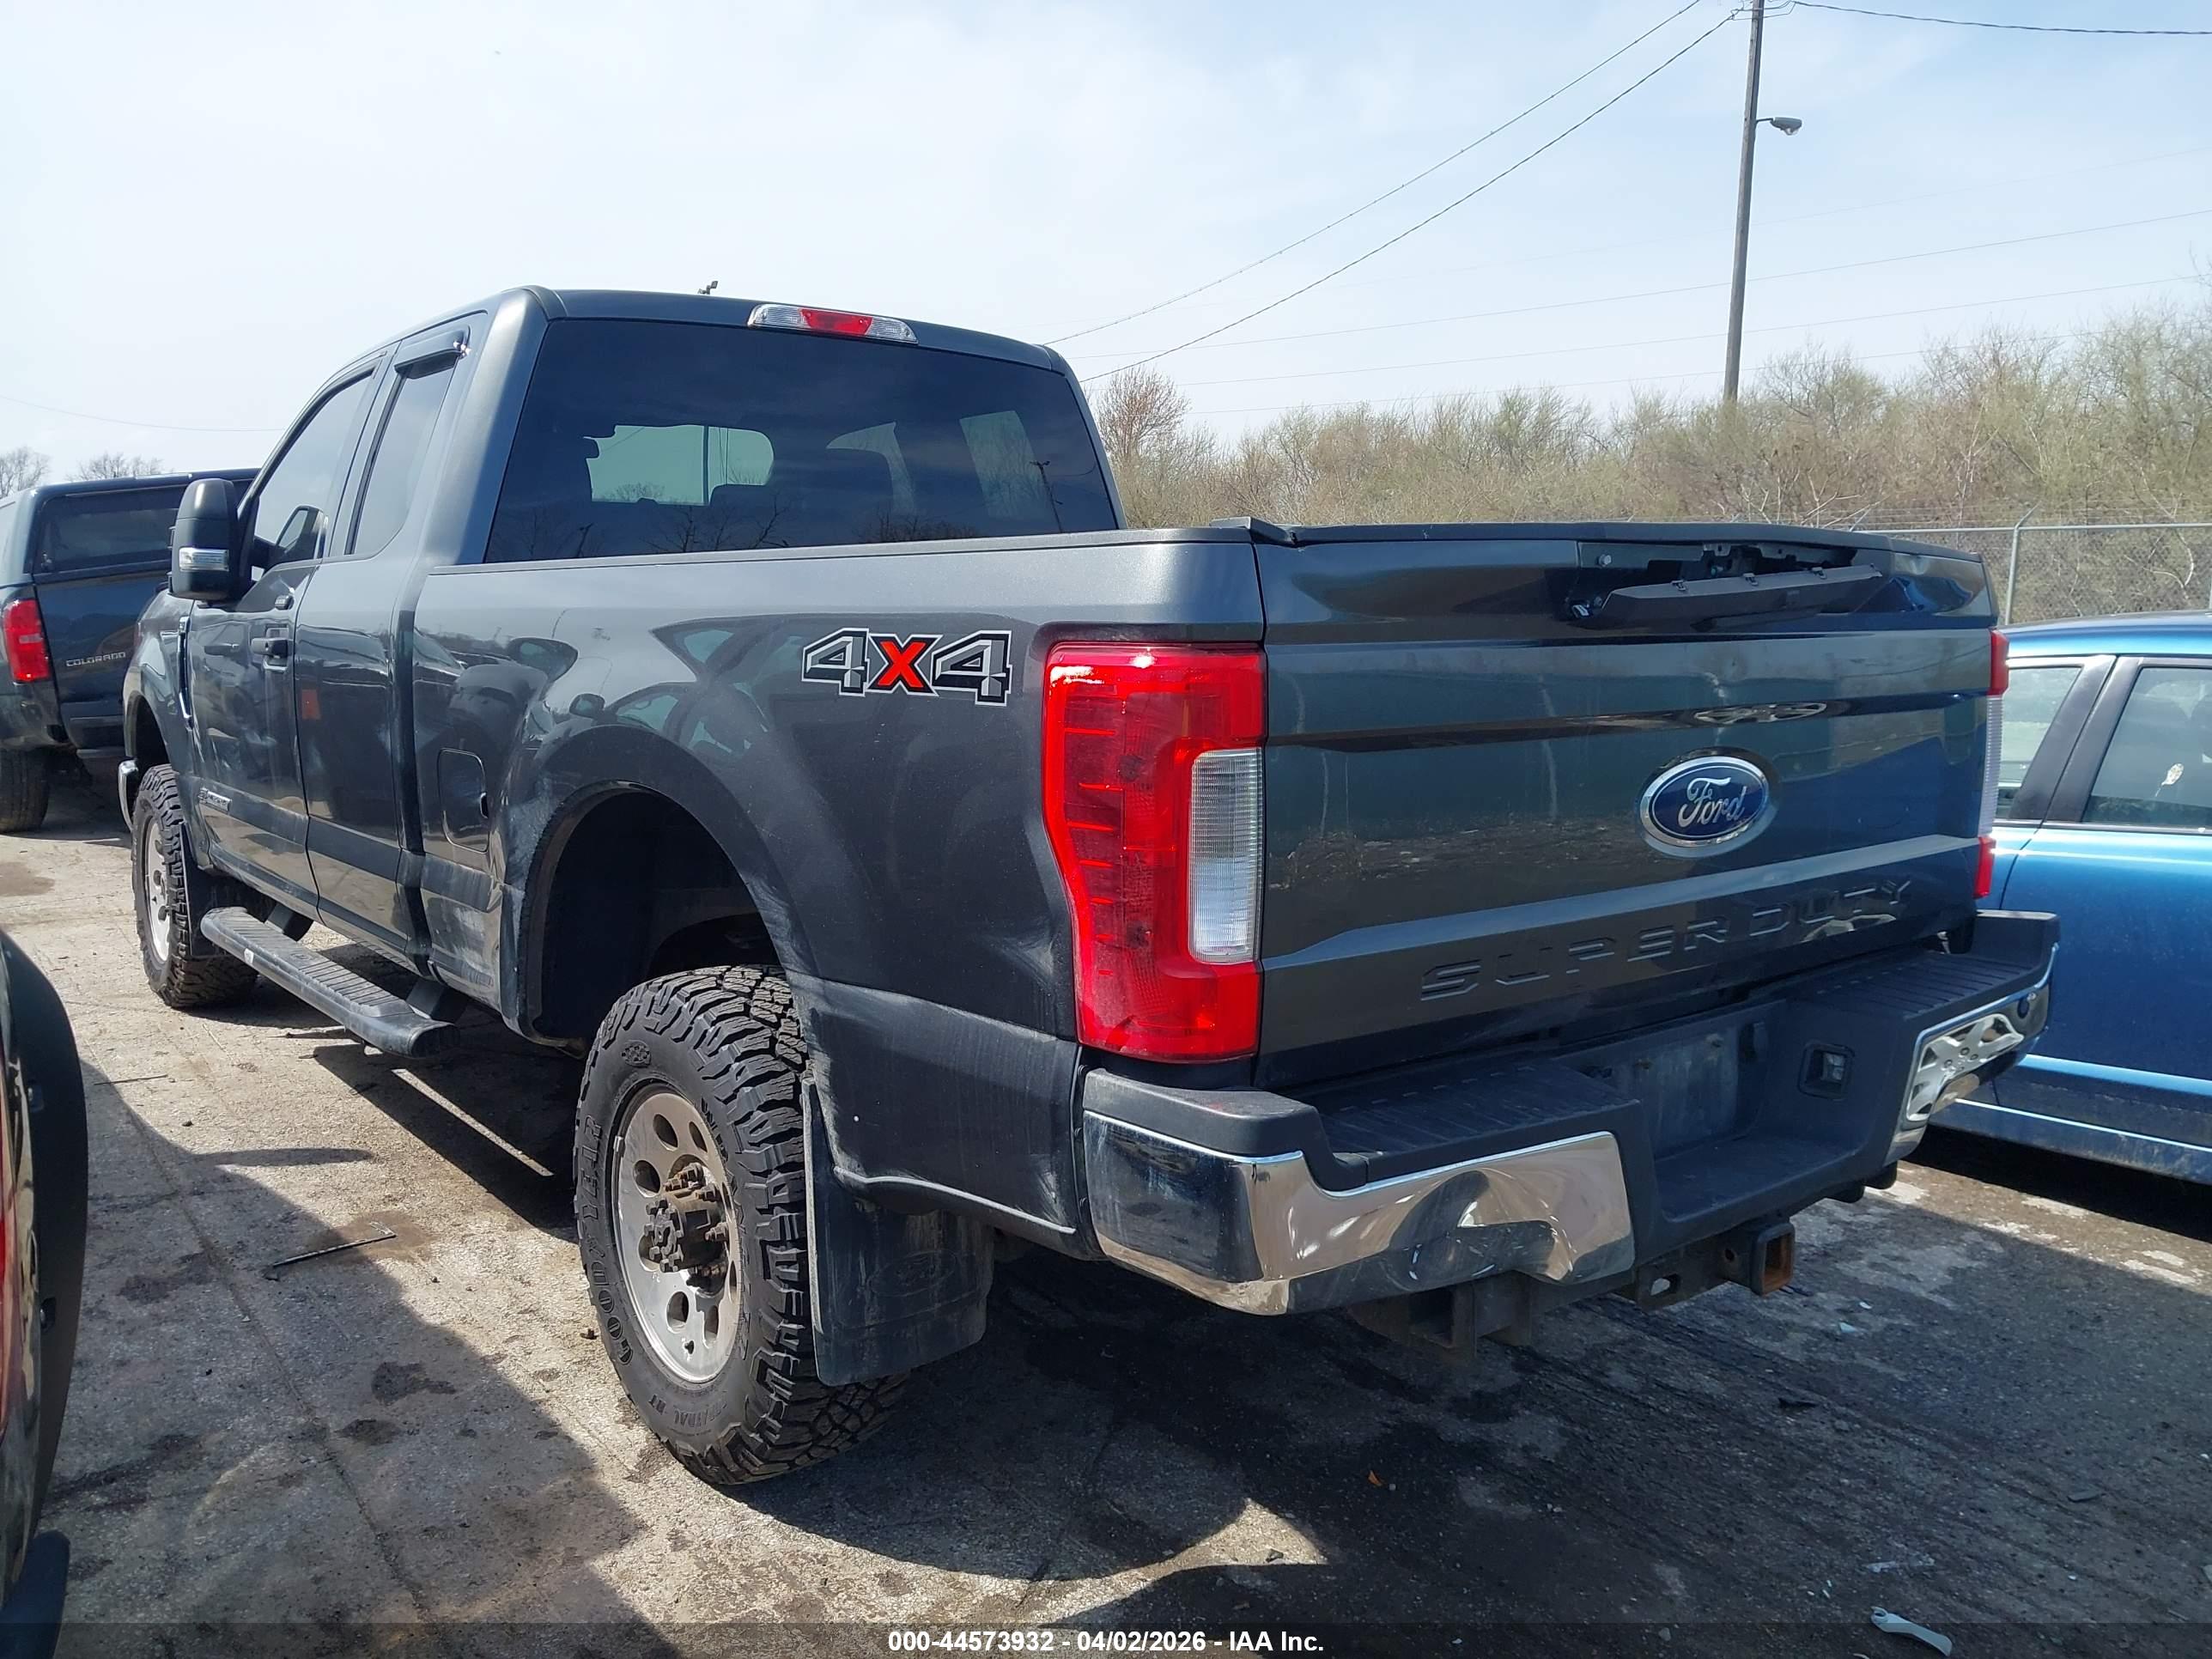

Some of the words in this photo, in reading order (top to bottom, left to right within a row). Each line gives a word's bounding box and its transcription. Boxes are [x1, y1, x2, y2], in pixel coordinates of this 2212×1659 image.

[65, 651, 126, 667] COLORADO
[1677, 776, 1747, 828] Ford
[1419, 919, 1728, 1002] SUPER
[1748, 880, 1912, 937] DUTY
[580, 1114, 634, 1366] GOODYEAR
